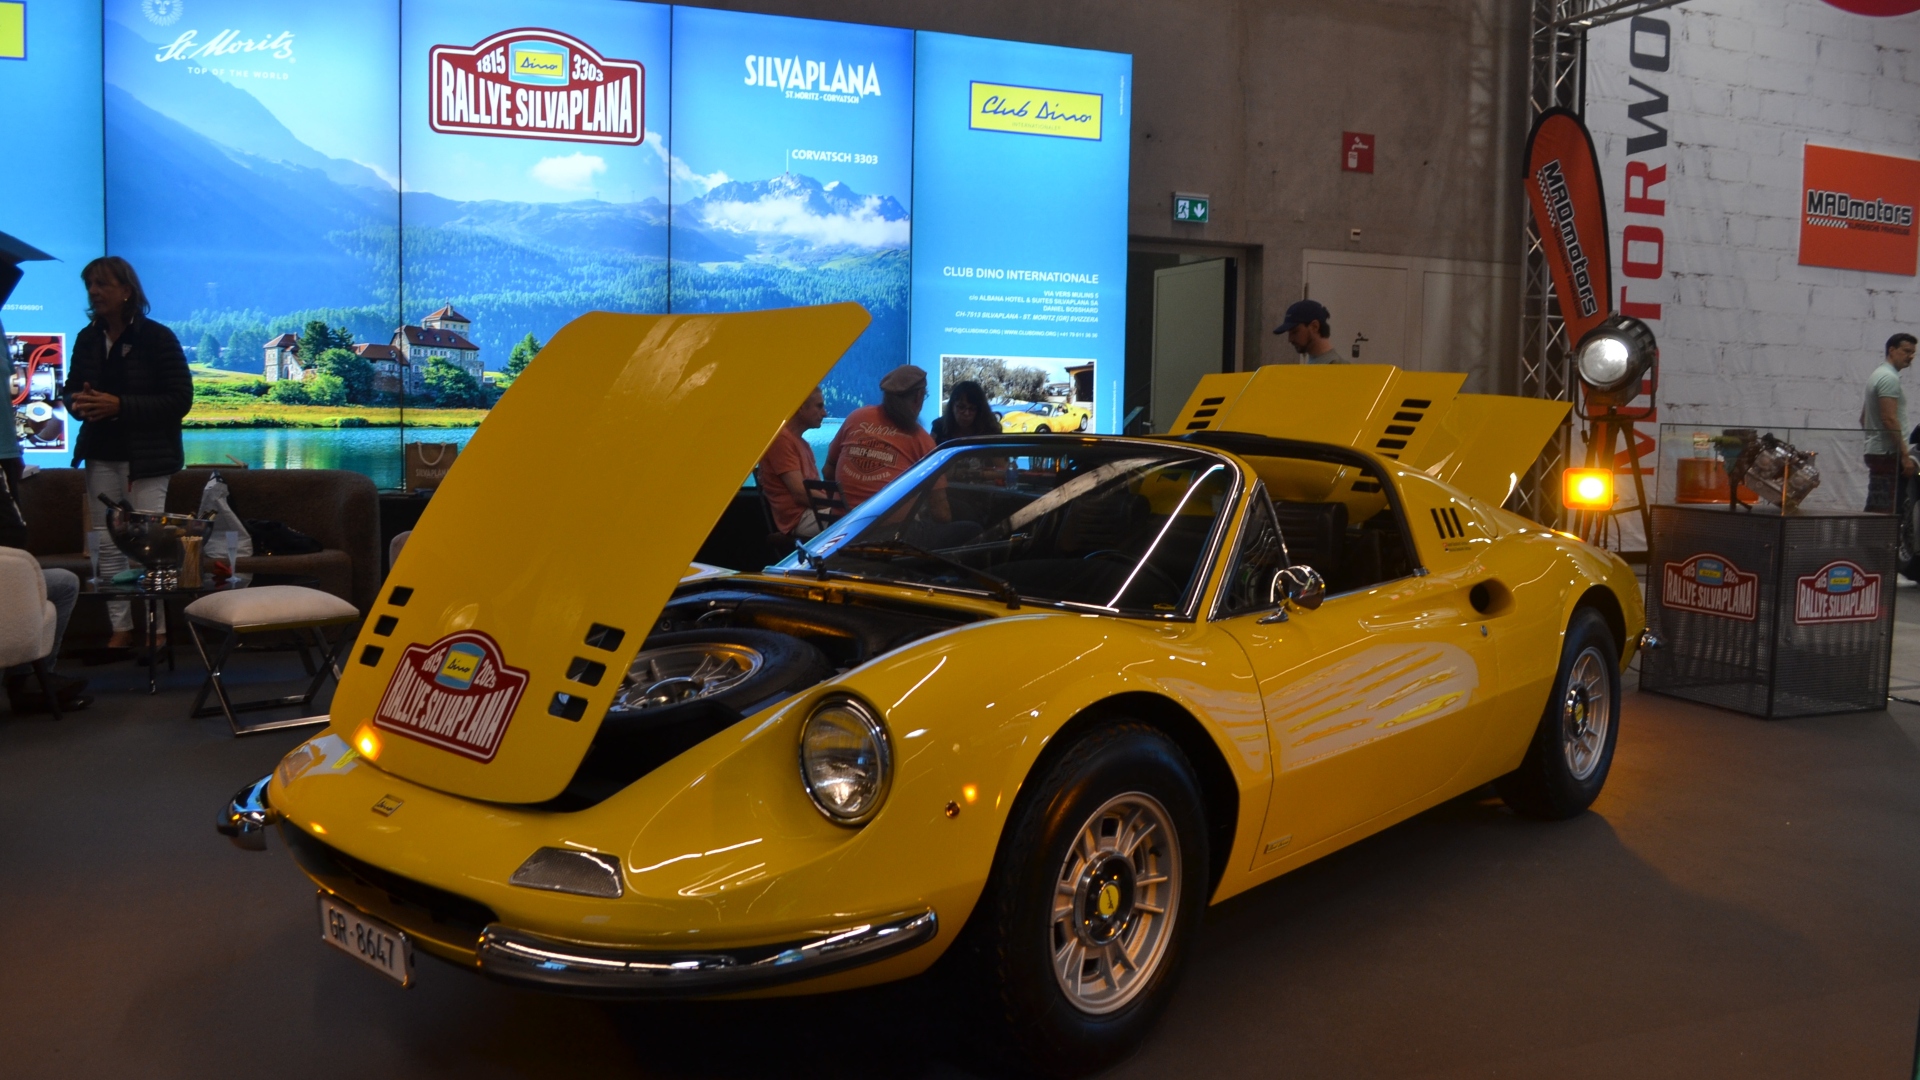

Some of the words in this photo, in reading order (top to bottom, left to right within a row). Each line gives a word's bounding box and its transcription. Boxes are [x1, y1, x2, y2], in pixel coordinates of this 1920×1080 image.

[155, 29, 198, 62] St.
[187, 29, 296, 60] Moritz
[187, 66, 207, 75] TOP
[211, 68, 225, 76] OF
[229, 69, 249, 78] THE
[253, 71, 289, 80] WORLD
[476, 46, 506, 74] 1815
[571, 54, 604, 82] 3303
[744, 54, 882, 99] SILVAPLANA
[441, 58, 512, 126] RALLYE
[515, 75, 633, 134] SILVAPLANA
[822, 93, 860, 104] CORVATSCH
[981, 95, 1031, 117] Club
[1035, 101, 1092, 123] Dino
[791, 149, 852, 163] CORVATSCH
[853, 154, 879, 165] 3303
[1806, 188, 1913, 227] MADmotors
[1542, 159, 1598, 318] MADmotors
[943, 266, 973, 278] CLUB
[976, 268, 1004, 280] DINO
[1006, 270, 1099, 284] INTERNATIONALE
[981, 311, 1019, 320] SILVAPLANA
[1069, 315, 1099, 323] SVIZZERA
[1053, 298, 1090, 306] SILVAPLANA
[1666, 568, 1698, 606] RALLYE
[1698, 580, 1752, 616] SILVAPLANA
[1799, 583, 1829, 619] RALLYE
[1828, 580, 1876, 617] SILVAPLANA
[421, 647, 447, 674] 1815
[474, 659, 497, 689] 2025
[381, 657, 432, 726] RALLYE
[419, 685, 515, 749] SILVAPLANA
